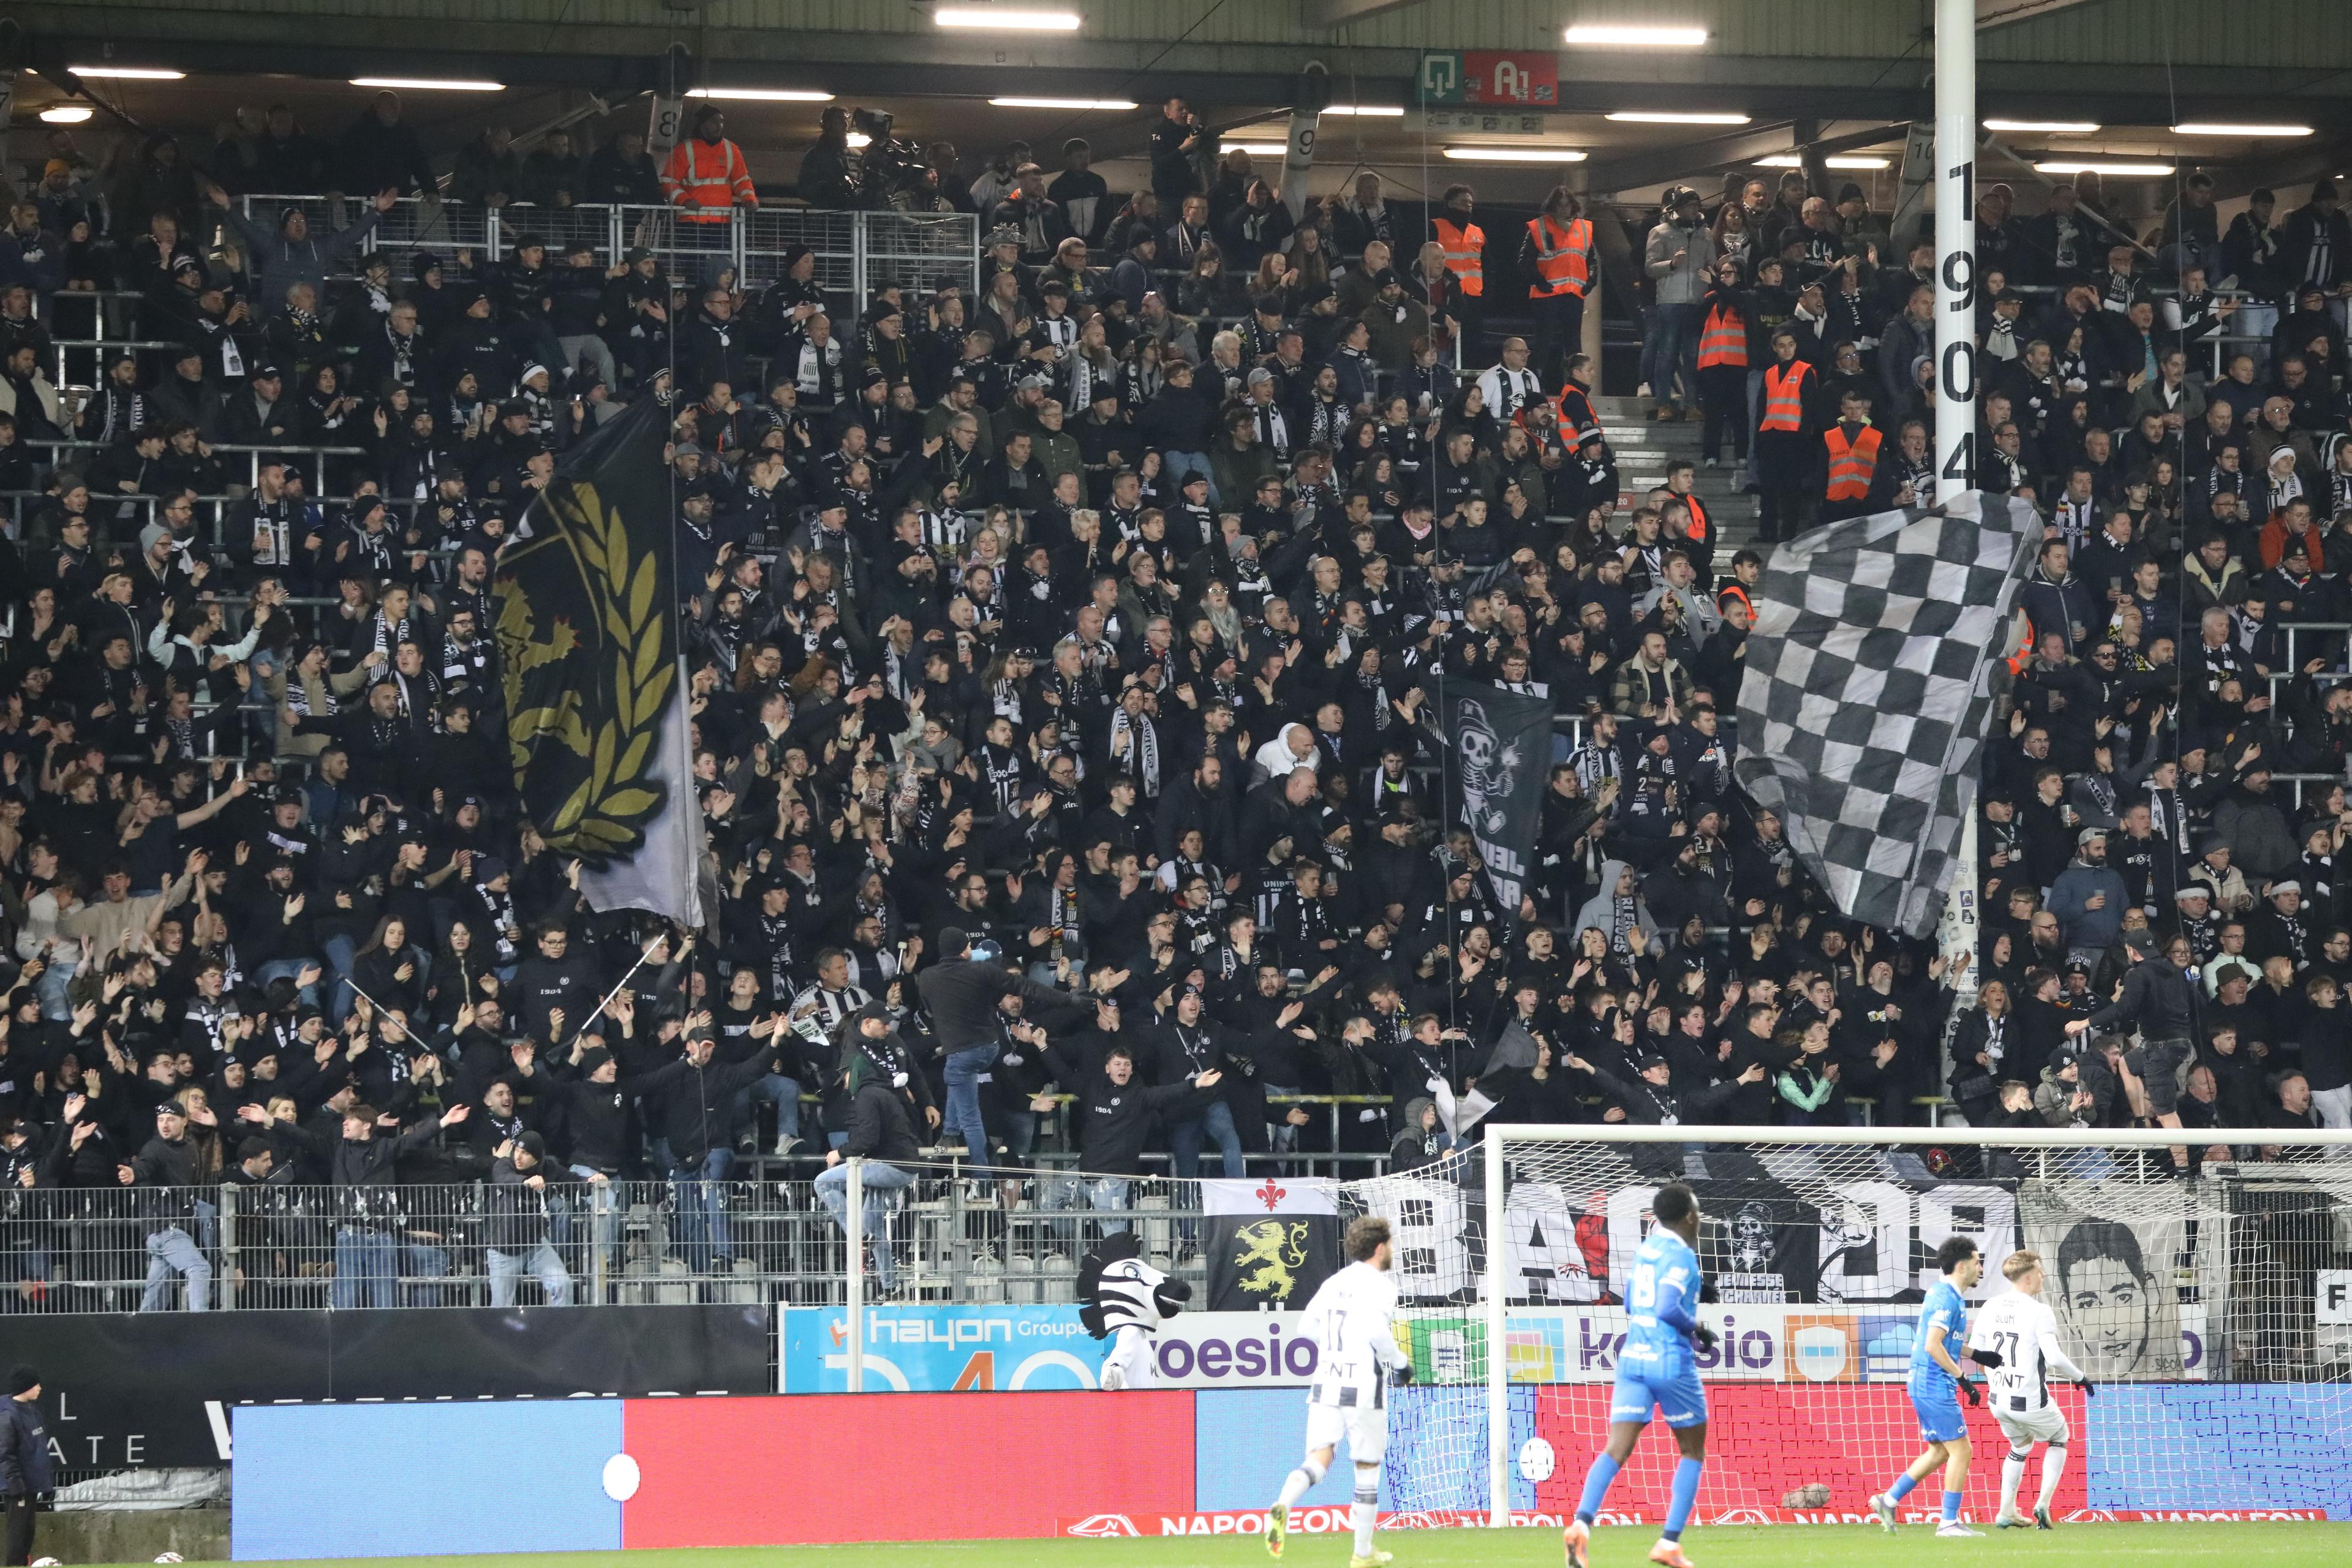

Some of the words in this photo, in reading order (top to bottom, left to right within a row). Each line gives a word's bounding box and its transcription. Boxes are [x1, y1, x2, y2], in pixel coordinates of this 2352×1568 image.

[1494, 61, 1529, 96] A1
[658, 111, 677, 137] 8
[1299, 129, 1315, 155] 9
[1617, 497, 1628, 506] 20
[1095, 1106, 1112, 1114] 1904
[870, 1310, 1011, 1351] hayon
[1017, 1320, 1088, 1340] Groupe
[1328, 1309, 1348, 1351] 17
[1580, 1315, 1775, 1370] ksio
[1992, 1331, 2019, 1367] 27
